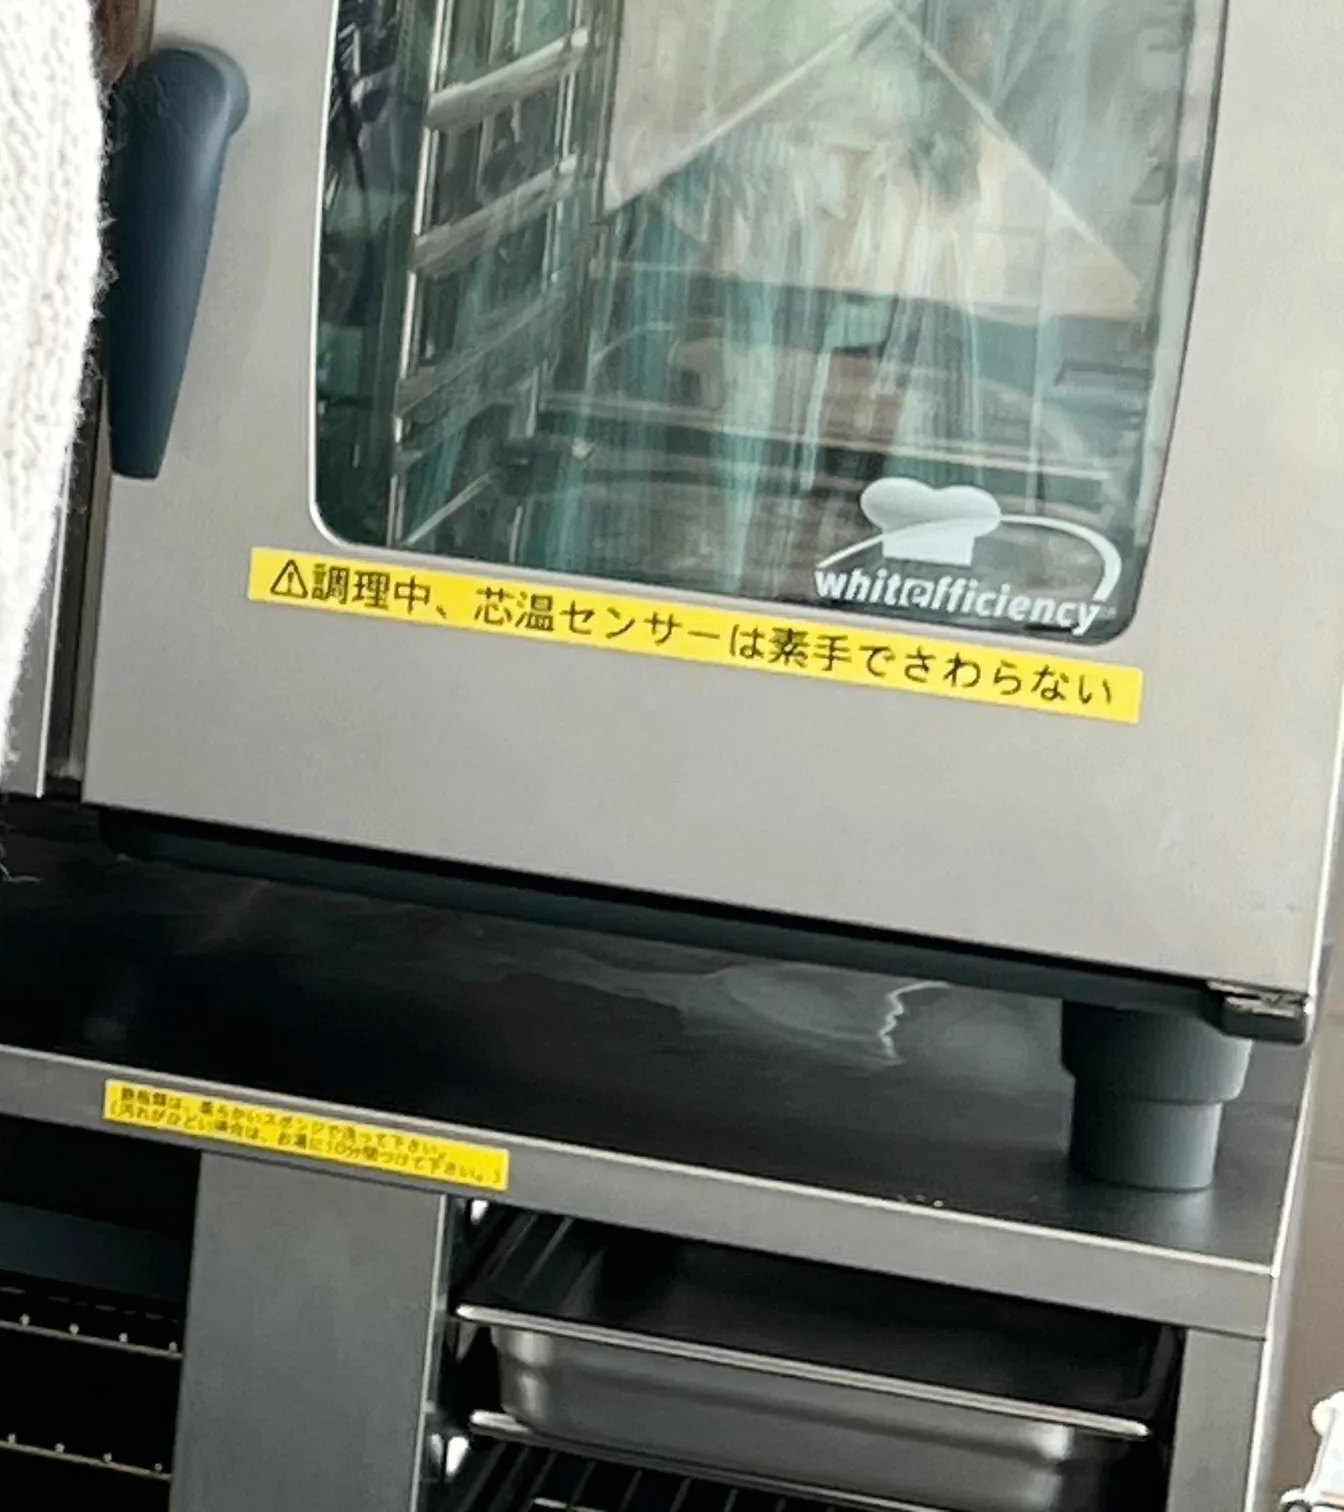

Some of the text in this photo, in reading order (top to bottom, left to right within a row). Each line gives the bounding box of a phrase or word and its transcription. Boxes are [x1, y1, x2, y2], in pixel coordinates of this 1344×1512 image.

[311, 562, 1113, 706] 調理中、芯温センサーは素手でさわらない
